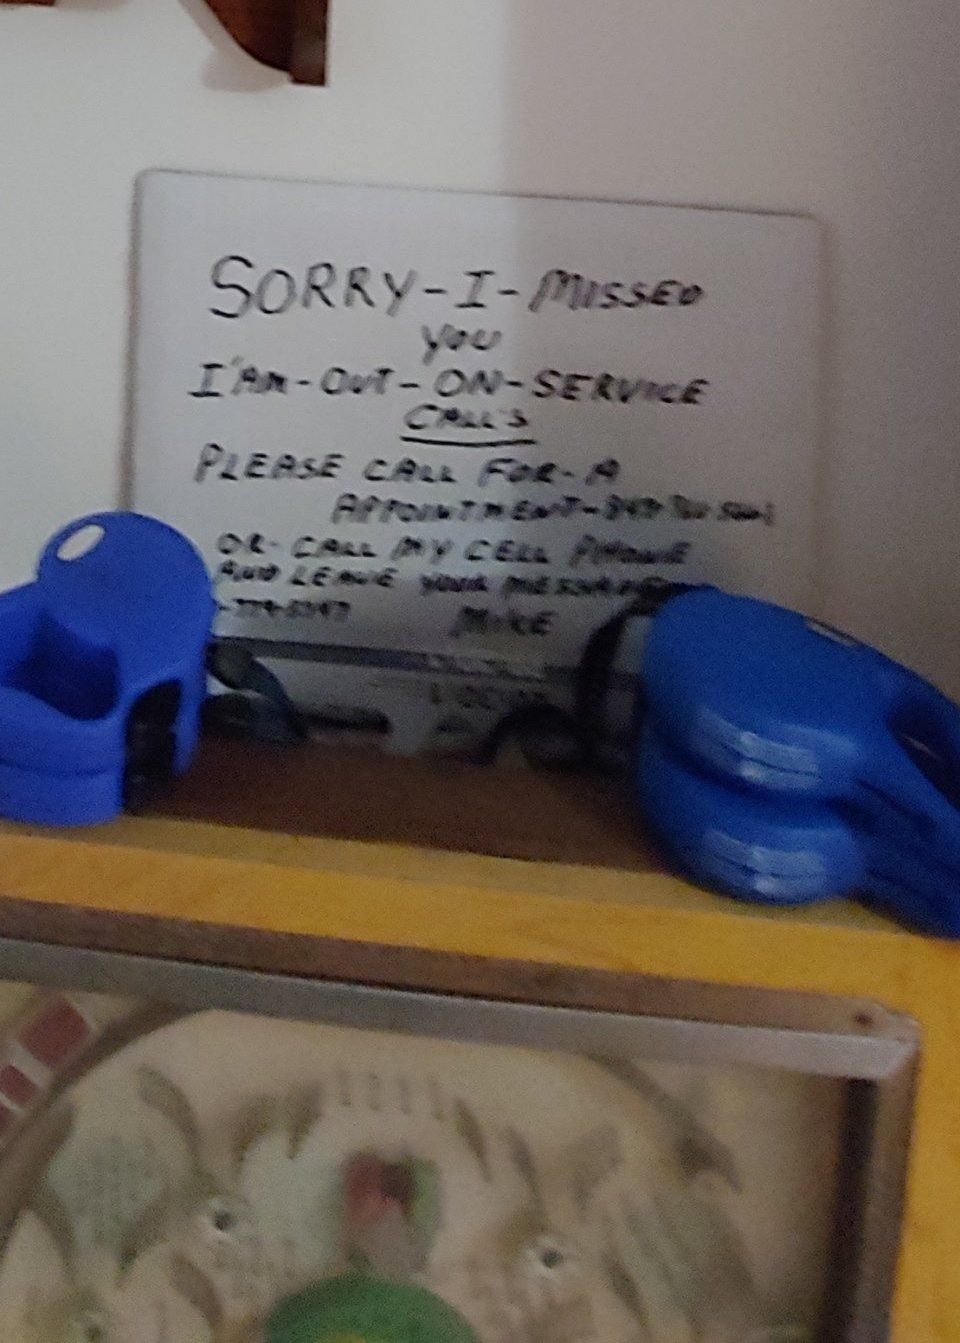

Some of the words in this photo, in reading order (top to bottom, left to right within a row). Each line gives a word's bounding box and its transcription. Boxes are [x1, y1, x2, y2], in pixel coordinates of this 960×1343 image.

[421, 323, 502, 364] YOU
[193, 442, 344, 483] PLEASE
[364, 458, 456, 483] CALL
[292, 535, 377, 559] CALL
[464, 539, 548, 563] CELL
